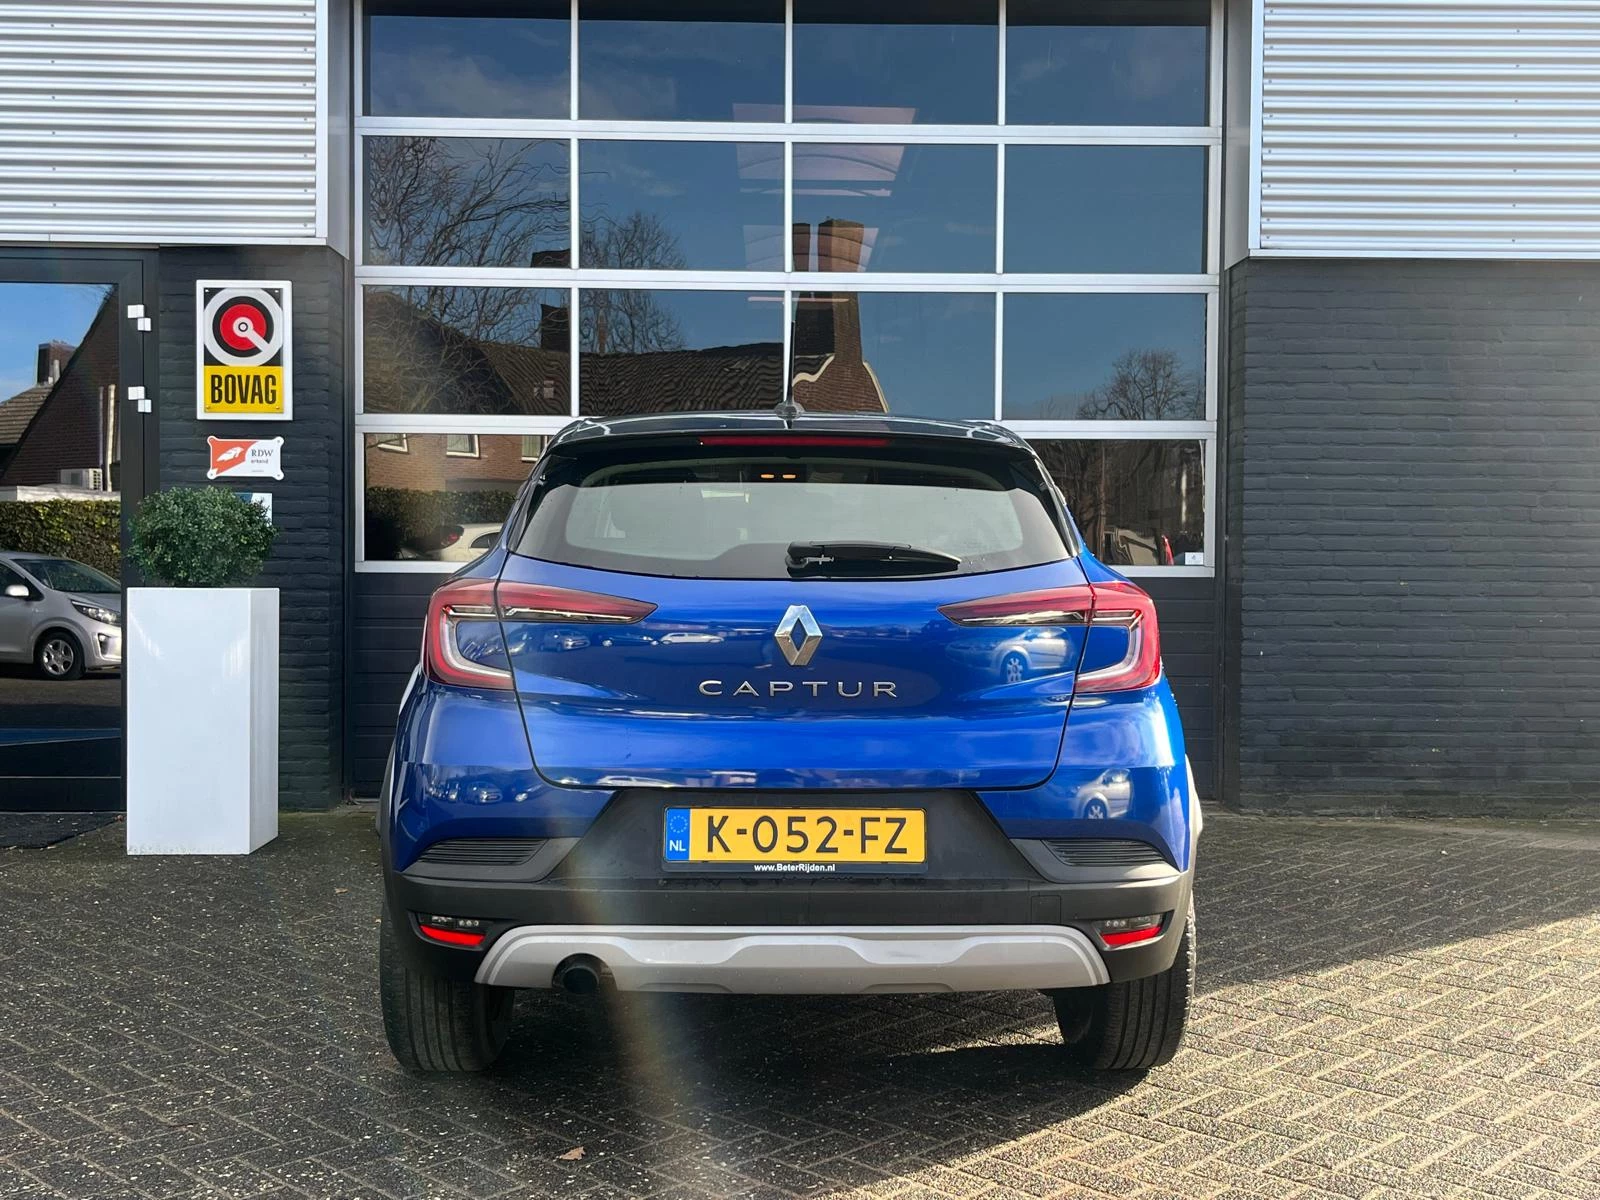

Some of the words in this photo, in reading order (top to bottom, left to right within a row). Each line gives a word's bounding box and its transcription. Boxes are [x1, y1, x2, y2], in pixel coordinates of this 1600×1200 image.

[210, 374, 277, 405] BOVAG
[251, 449, 274, 457] RDW
[698, 680, 897, 698] CAPTUR
[706, 815, 908, 855] K-052-FZ
[669, 840, 687, 852] NL
[754, 863, 836, 873] www.BeterRijden.nl
